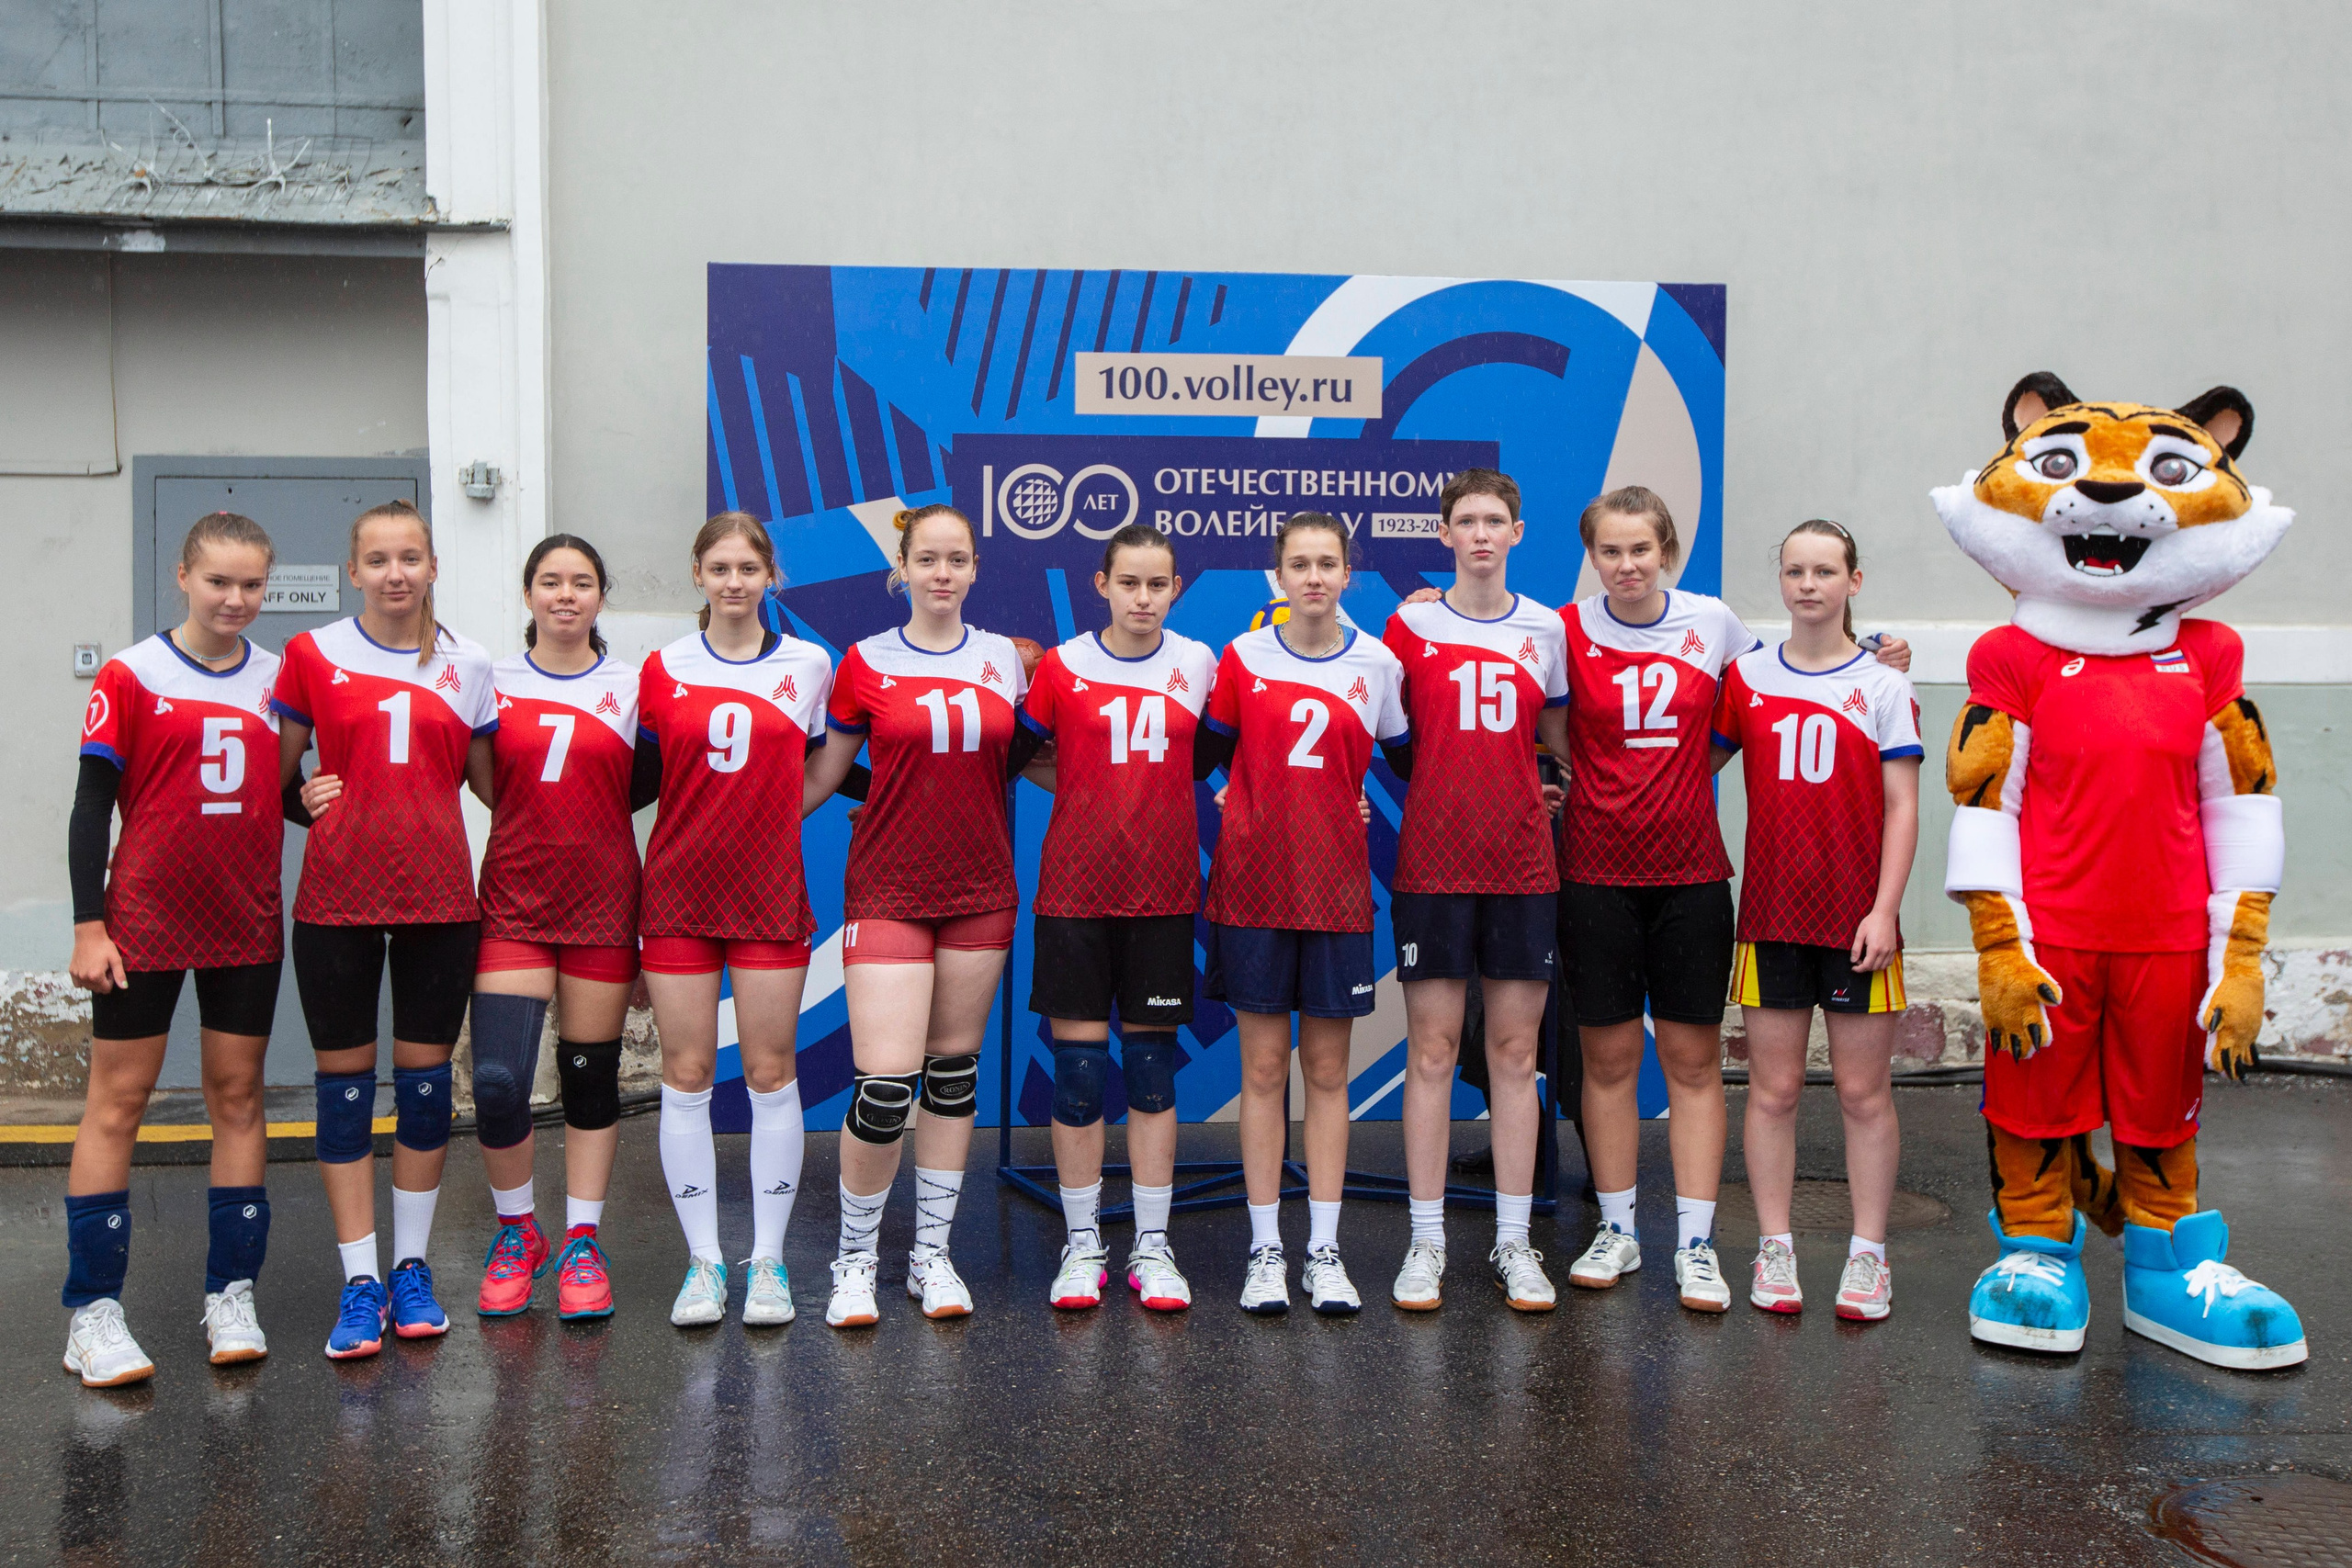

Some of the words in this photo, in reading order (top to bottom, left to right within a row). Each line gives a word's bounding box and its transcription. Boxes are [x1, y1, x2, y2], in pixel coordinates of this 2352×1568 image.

[1099, 365, 1352, 411] 100.volley.ru
[1083, 494, 1119, 510] ЛЕТ
[1154, 468, 1454, 497] ОТЕЧЕСТВЕННОМ
[1155, 503, 1364, 539] ВОЛЕЙБУ
[1378, 518, 1444, 533] 1923-20
[289, 592, 326, 603] ONLY
[378, 691, 411, 764] 1
[915, 687, 982, 753] 11
[1449, 660, 1517, 733] 15
[1612, 662, 1678, 730] 12
[200, 716, 245, 795] 5
[538, 714, 575, 783] 7
[707, 702, 752, 773] 9
[1099, 695, 1170, 764] 14
[1288, 698, 1329, 769] 2
[1771, 713, 1838, 784] 10
[844, 922, 860, 948] 11
[1402, 942, 1418, 967] 10
[674, 1189, 708, 1199] DEMIX
